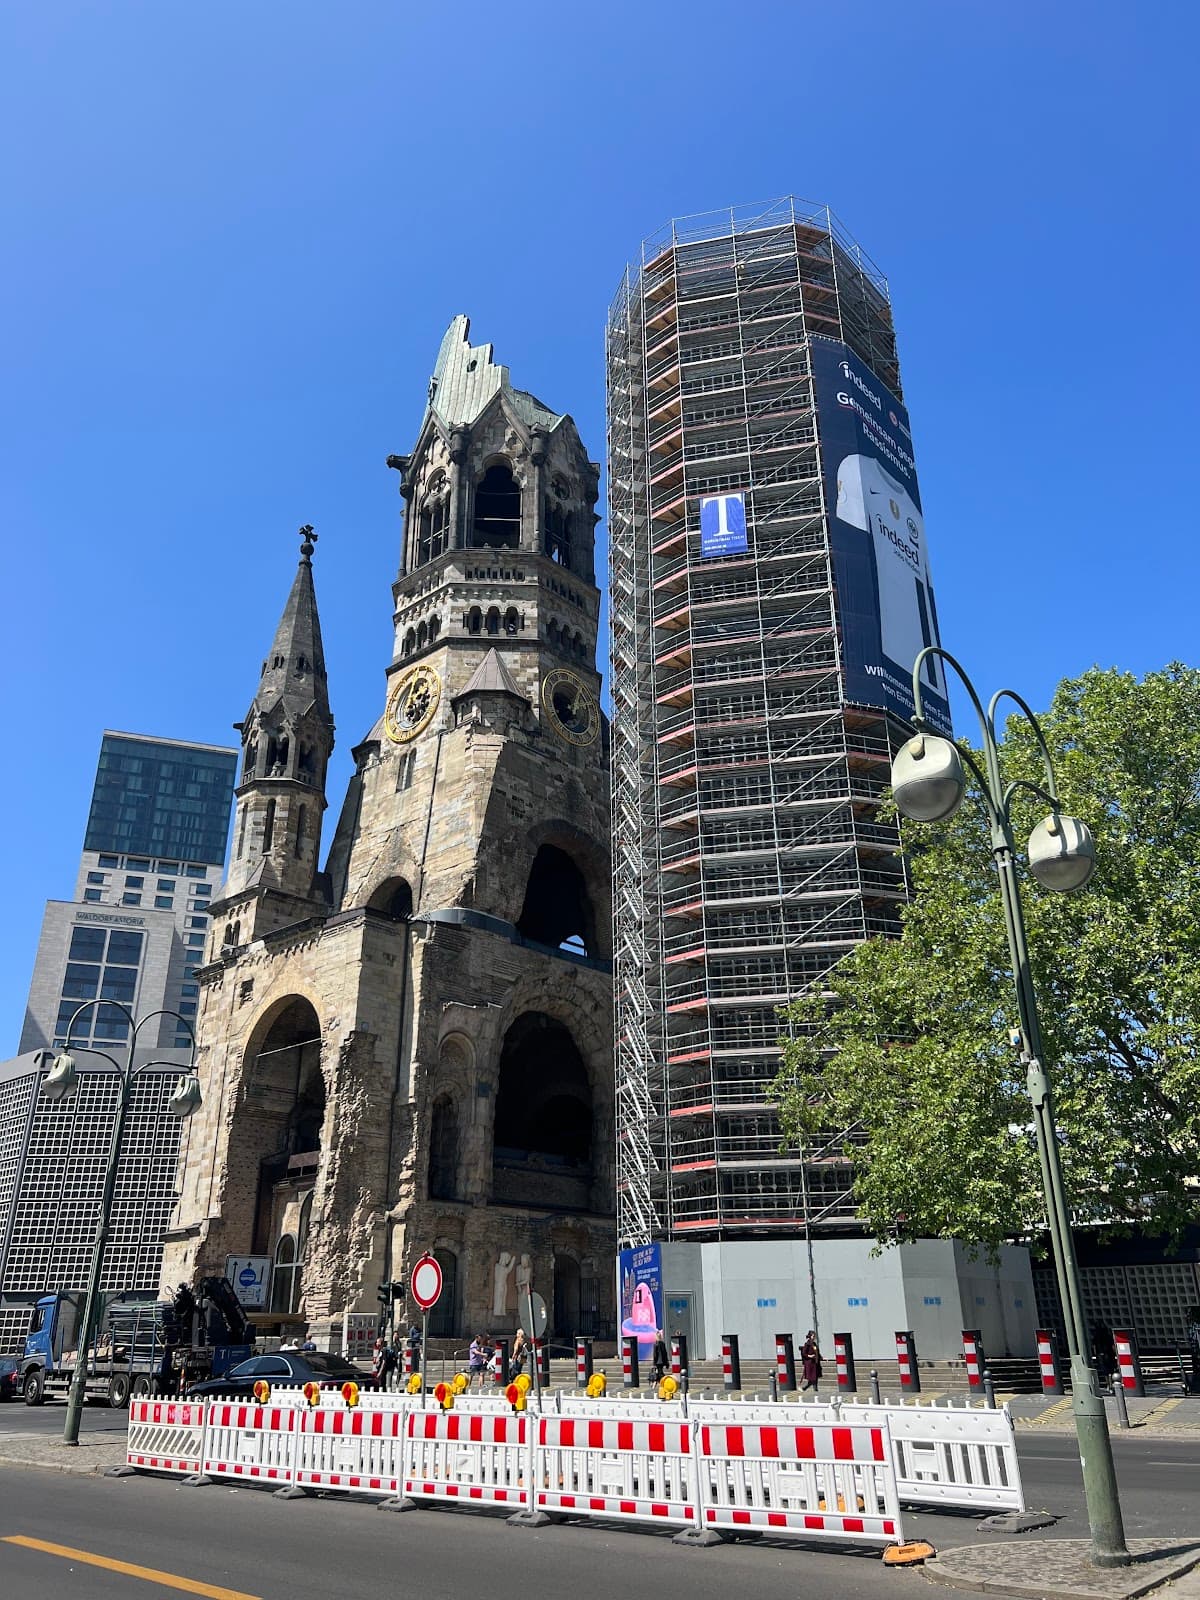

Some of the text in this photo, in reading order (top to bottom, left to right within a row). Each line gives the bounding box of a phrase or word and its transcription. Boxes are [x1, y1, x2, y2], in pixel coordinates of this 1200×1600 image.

[839, 361, 881, 411] indeed
[837, 392, 897, 450] Gemeinsam
[703, 493, 742, 536] T
[876, 513, 919, 567] indeed
[864, 665, 913, 697] Willkommen
[77, 912, 144, 926] WALDORF ASTORIA
